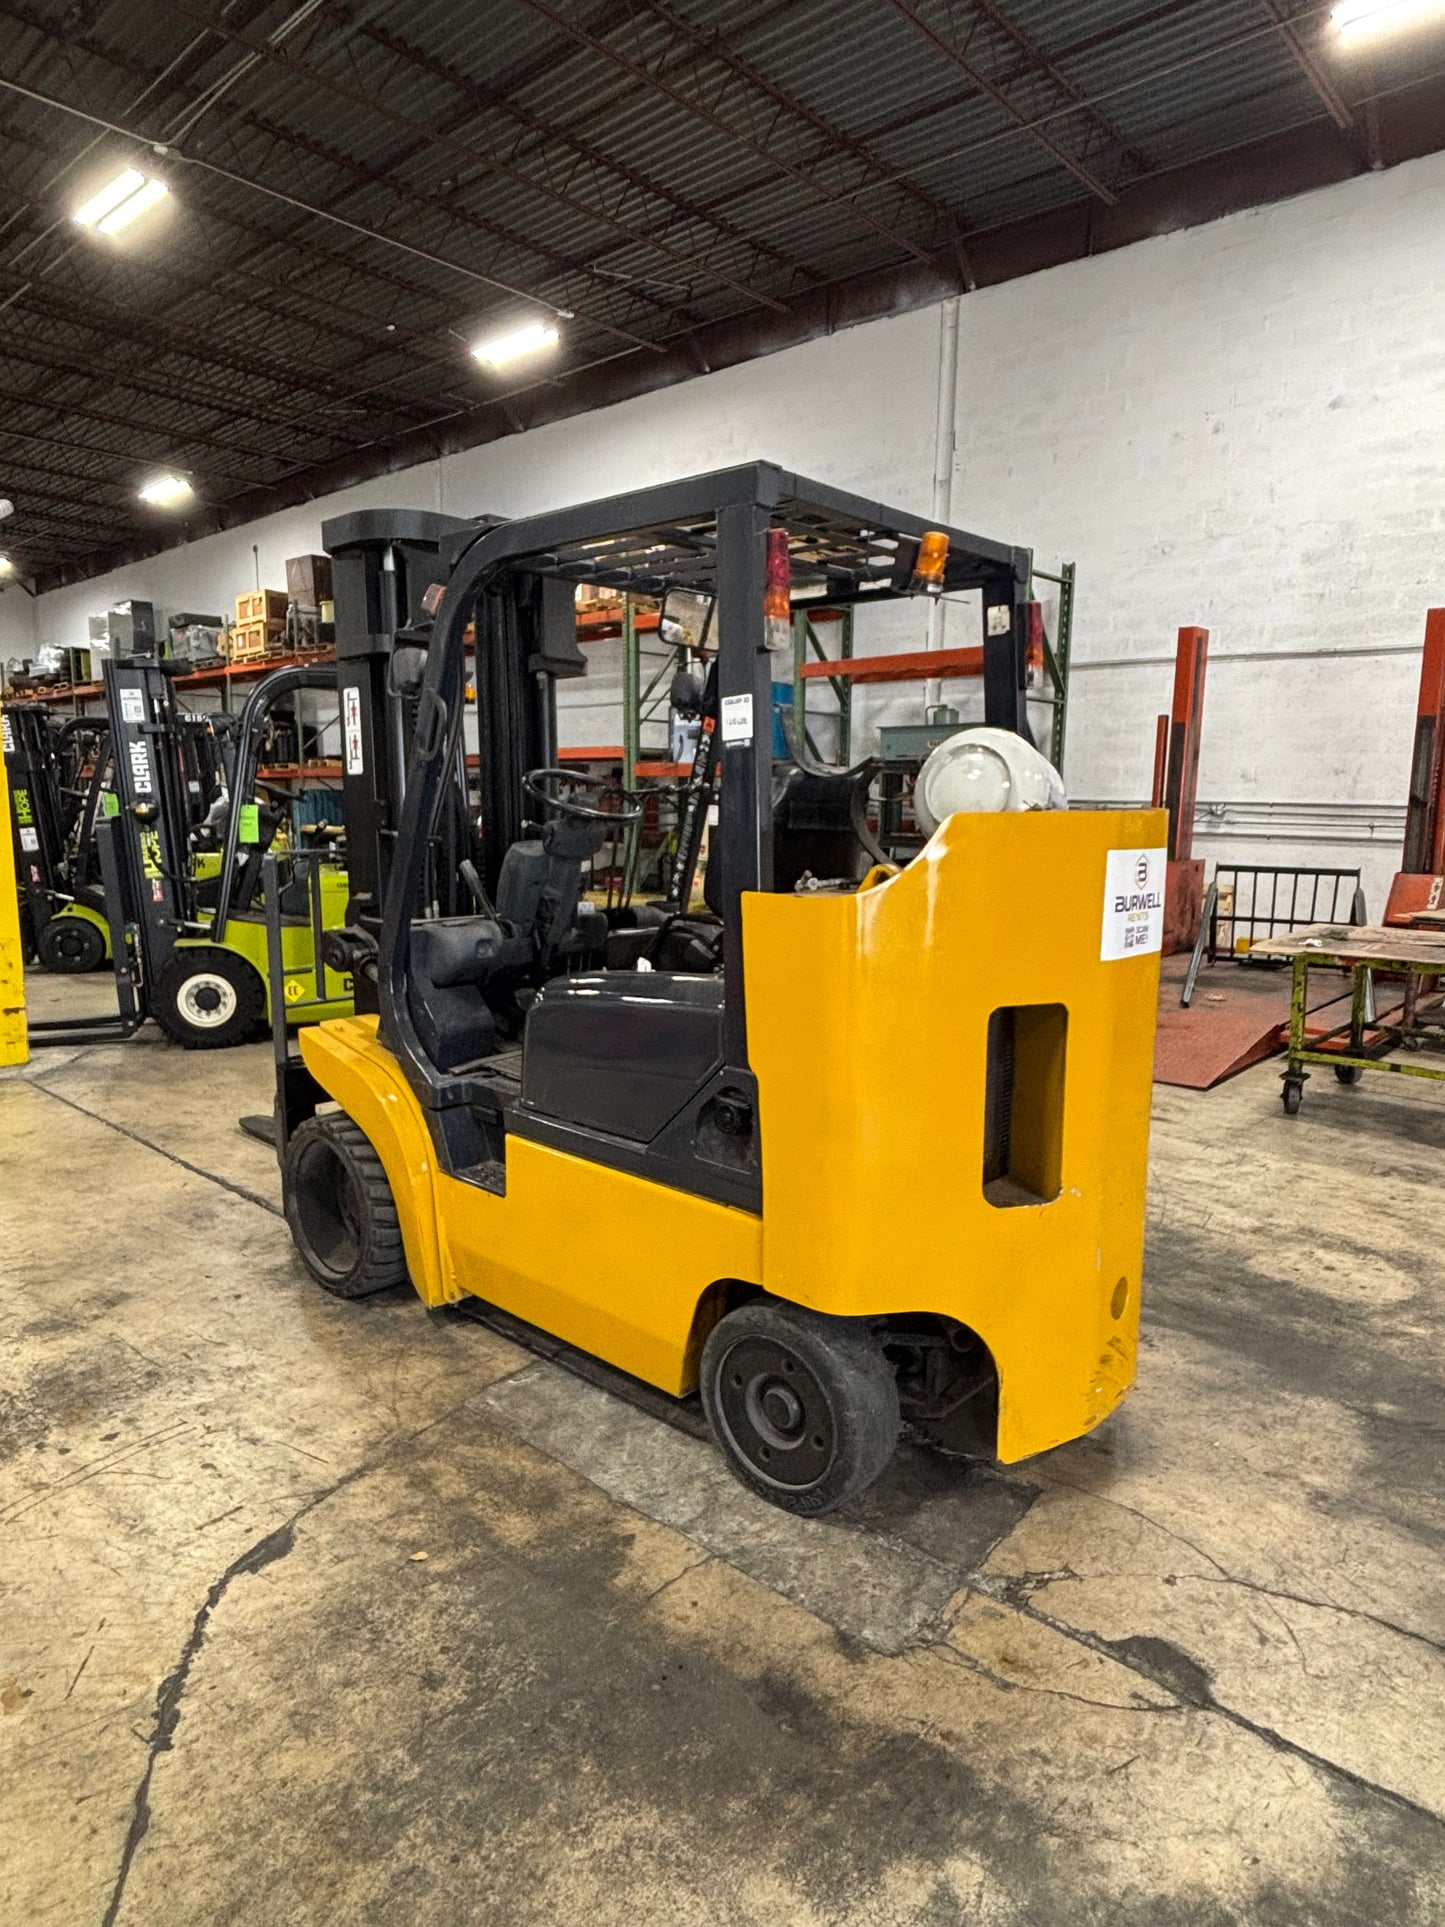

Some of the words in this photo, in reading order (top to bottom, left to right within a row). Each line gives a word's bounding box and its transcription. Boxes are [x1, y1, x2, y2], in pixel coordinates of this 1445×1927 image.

[129, 740, 152, 793] CLARK
[1114, 892, 1162, 913] BURWELL
[1127, 911, 1150, 923] RENTS
[287, 985, 299, 996] EE
